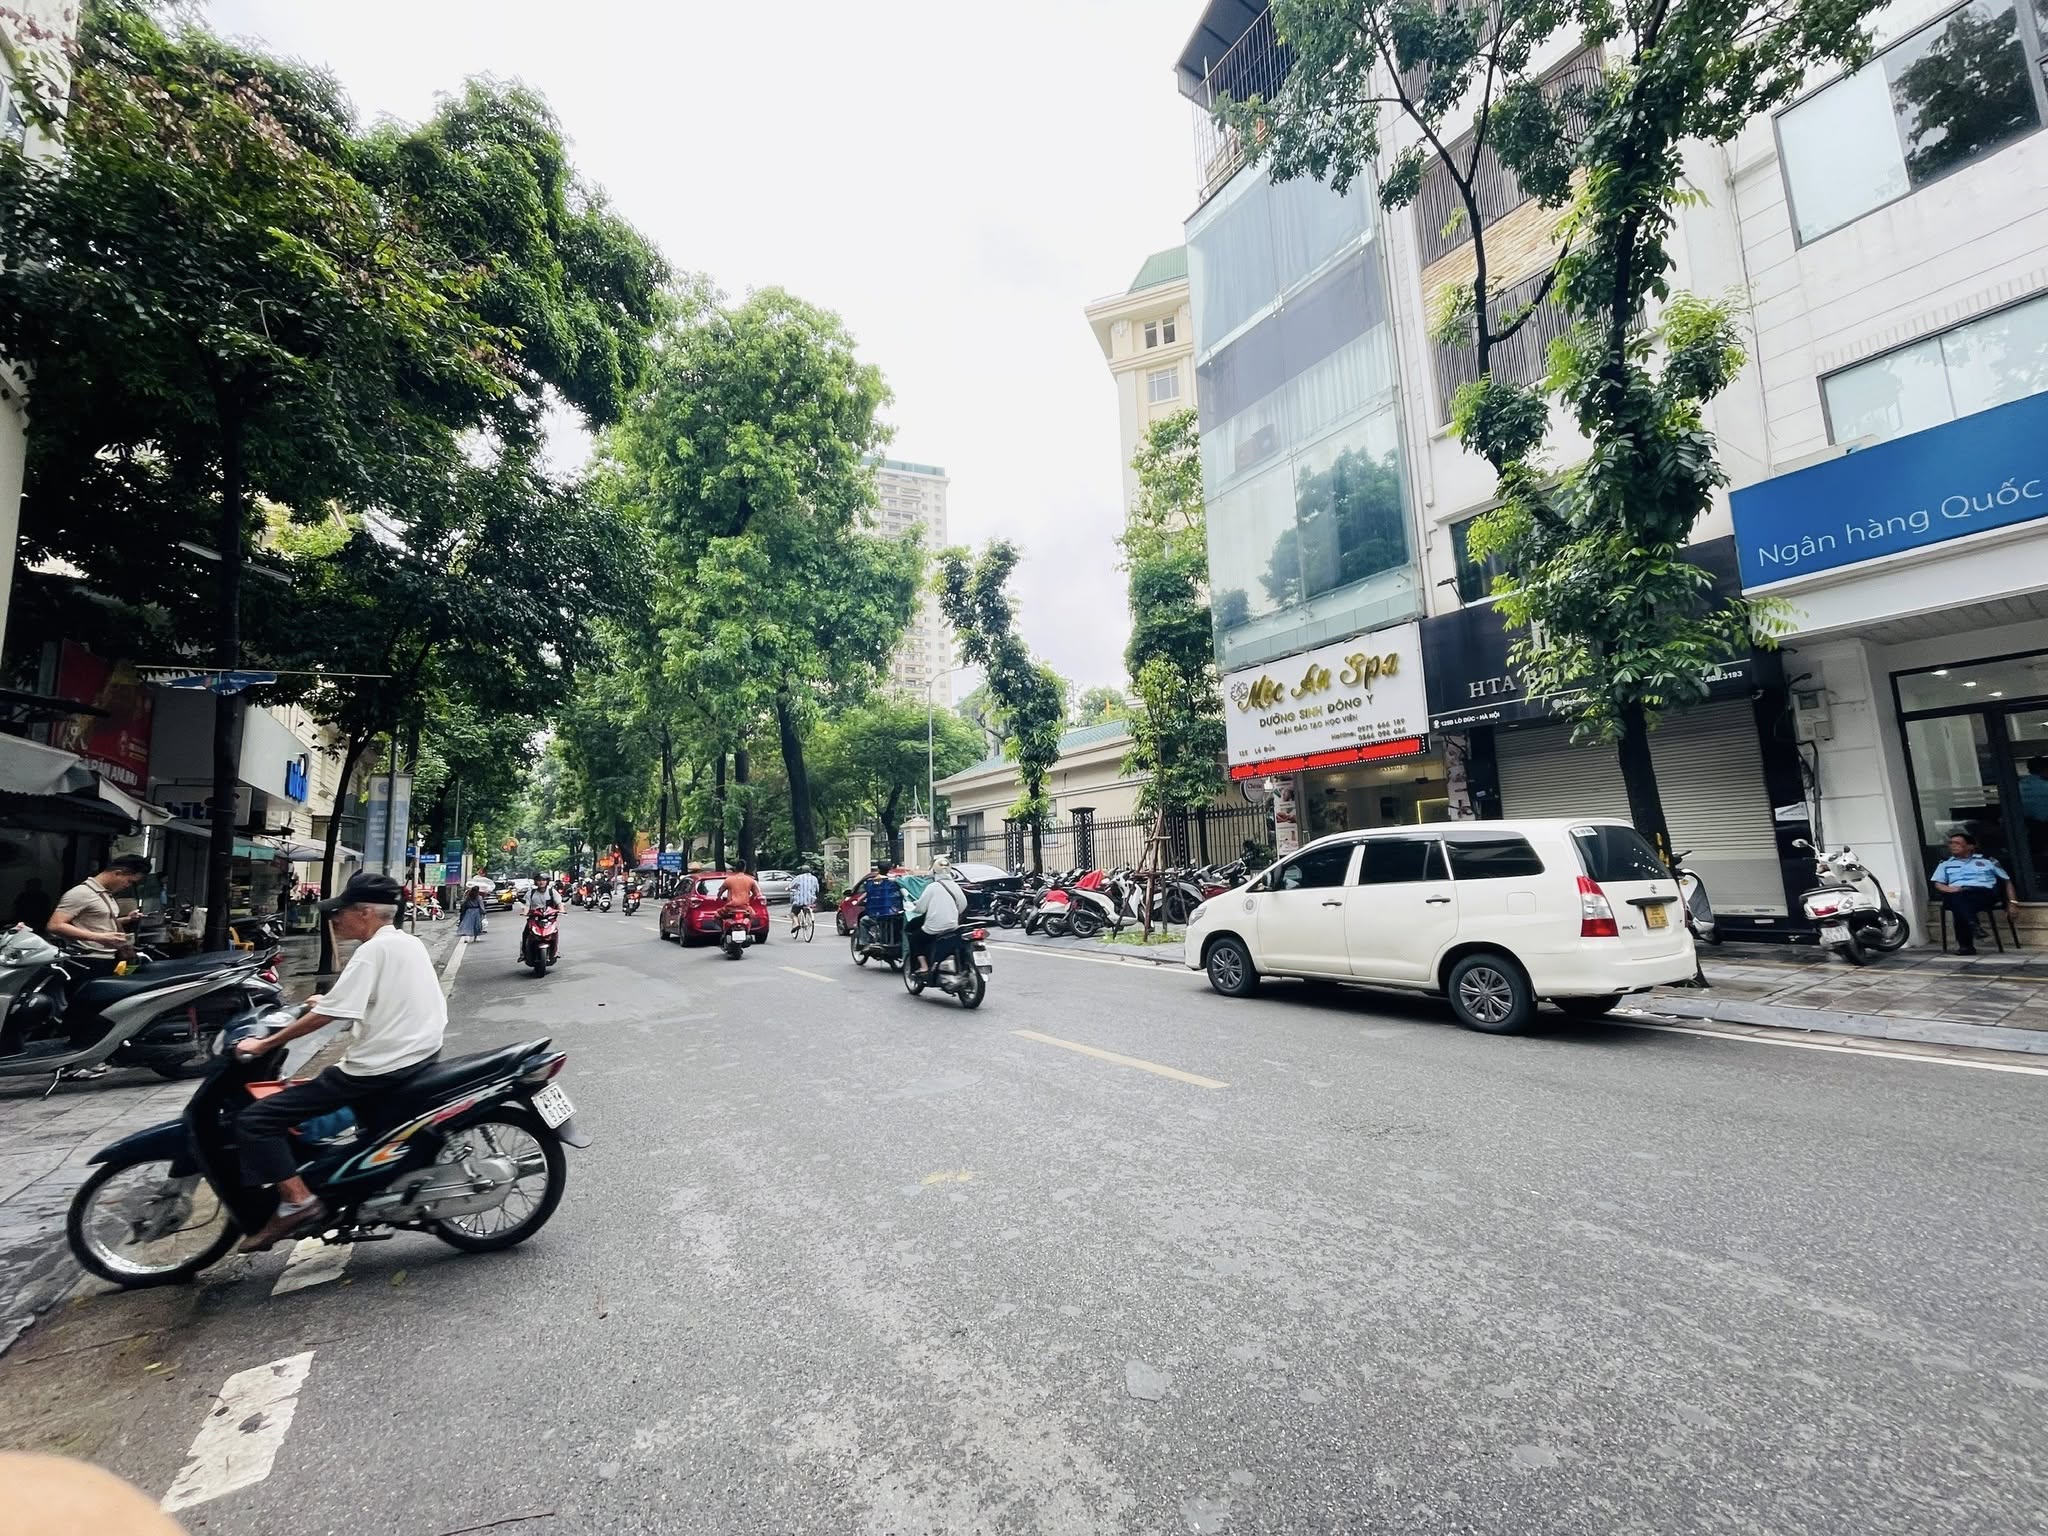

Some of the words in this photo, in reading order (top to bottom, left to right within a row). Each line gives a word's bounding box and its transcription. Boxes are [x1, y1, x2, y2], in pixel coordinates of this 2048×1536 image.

[1759, 536, 1836, 566] Ngân
[1846, 509, 1929, 545] hàng
[1941, 477, 2043, 519] Quốc
[1291, 663, 1331, 698] An
[1340, 652, 1397, 690] Spa
[1469, 675, 1517, 698] HTA
[1259, 712, 1295, 728] DƯỠNG
[1299, 705, 1323, 720] SINH
[1327, 698, 1361, 714] ĐÔNG
[1366, 694, 1373, 705] Y
